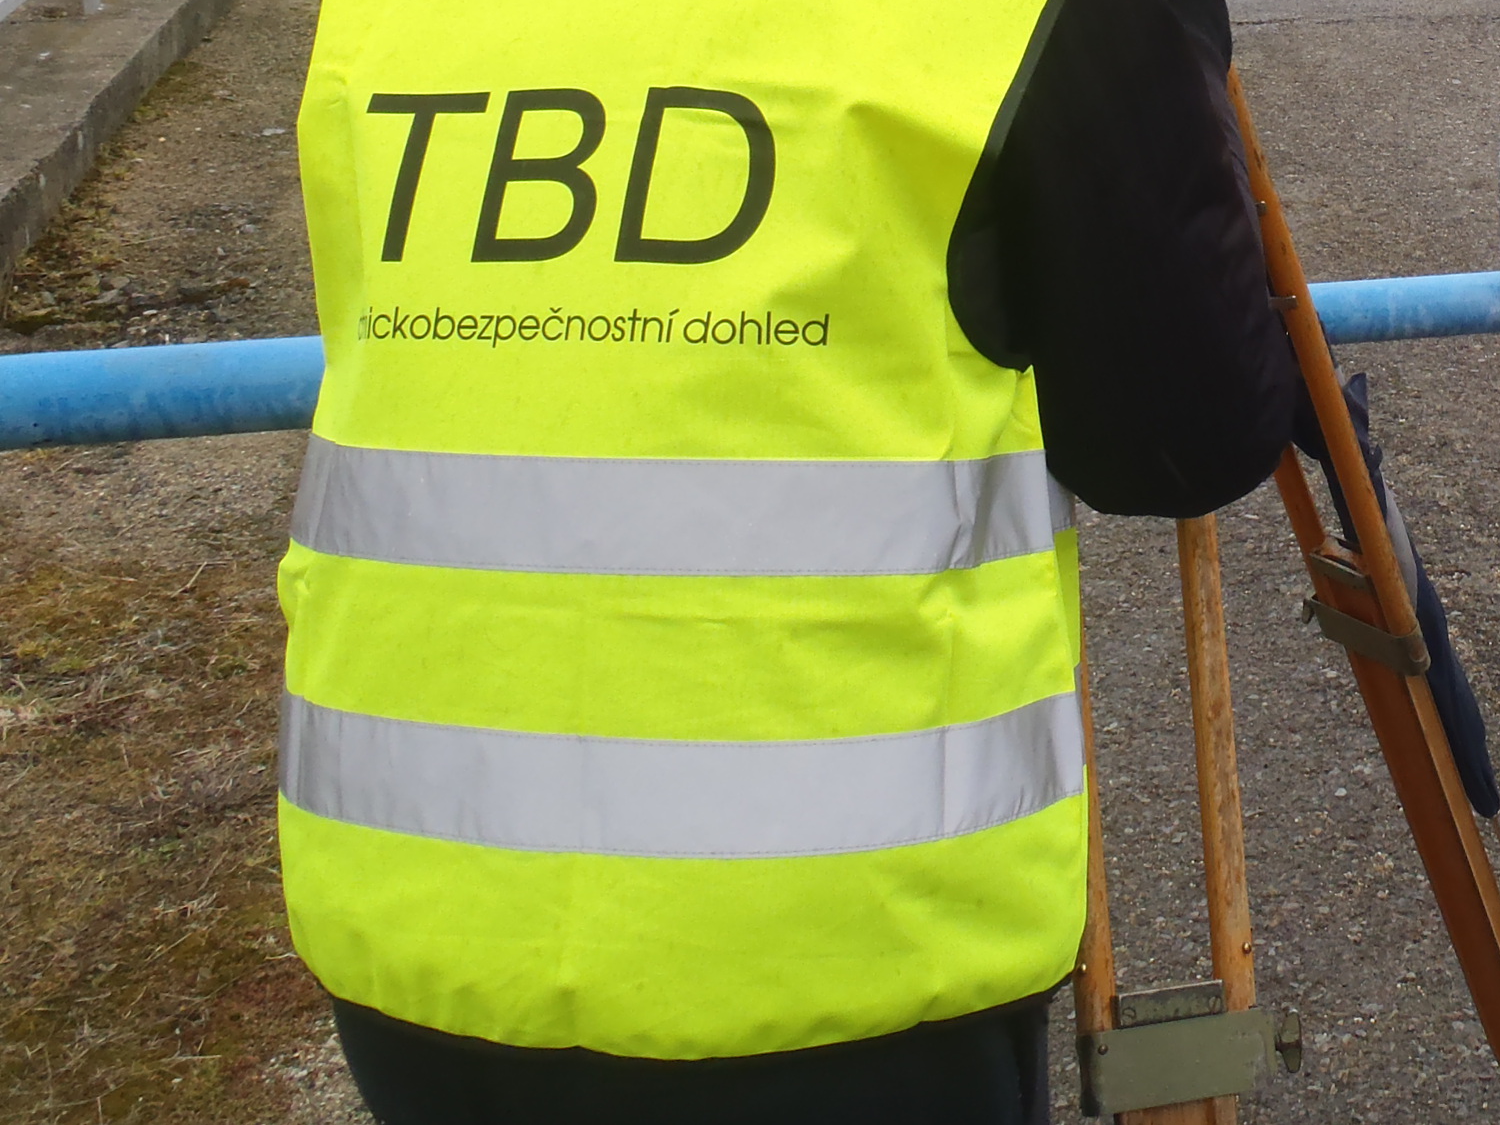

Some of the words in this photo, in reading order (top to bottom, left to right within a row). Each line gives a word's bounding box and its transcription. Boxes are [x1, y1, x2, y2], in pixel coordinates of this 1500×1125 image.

[366, 86, 776, 264] TBD
[358, 305, 679, 348] ickobezpečnostní
[682, 312, 830, 346] dohled
